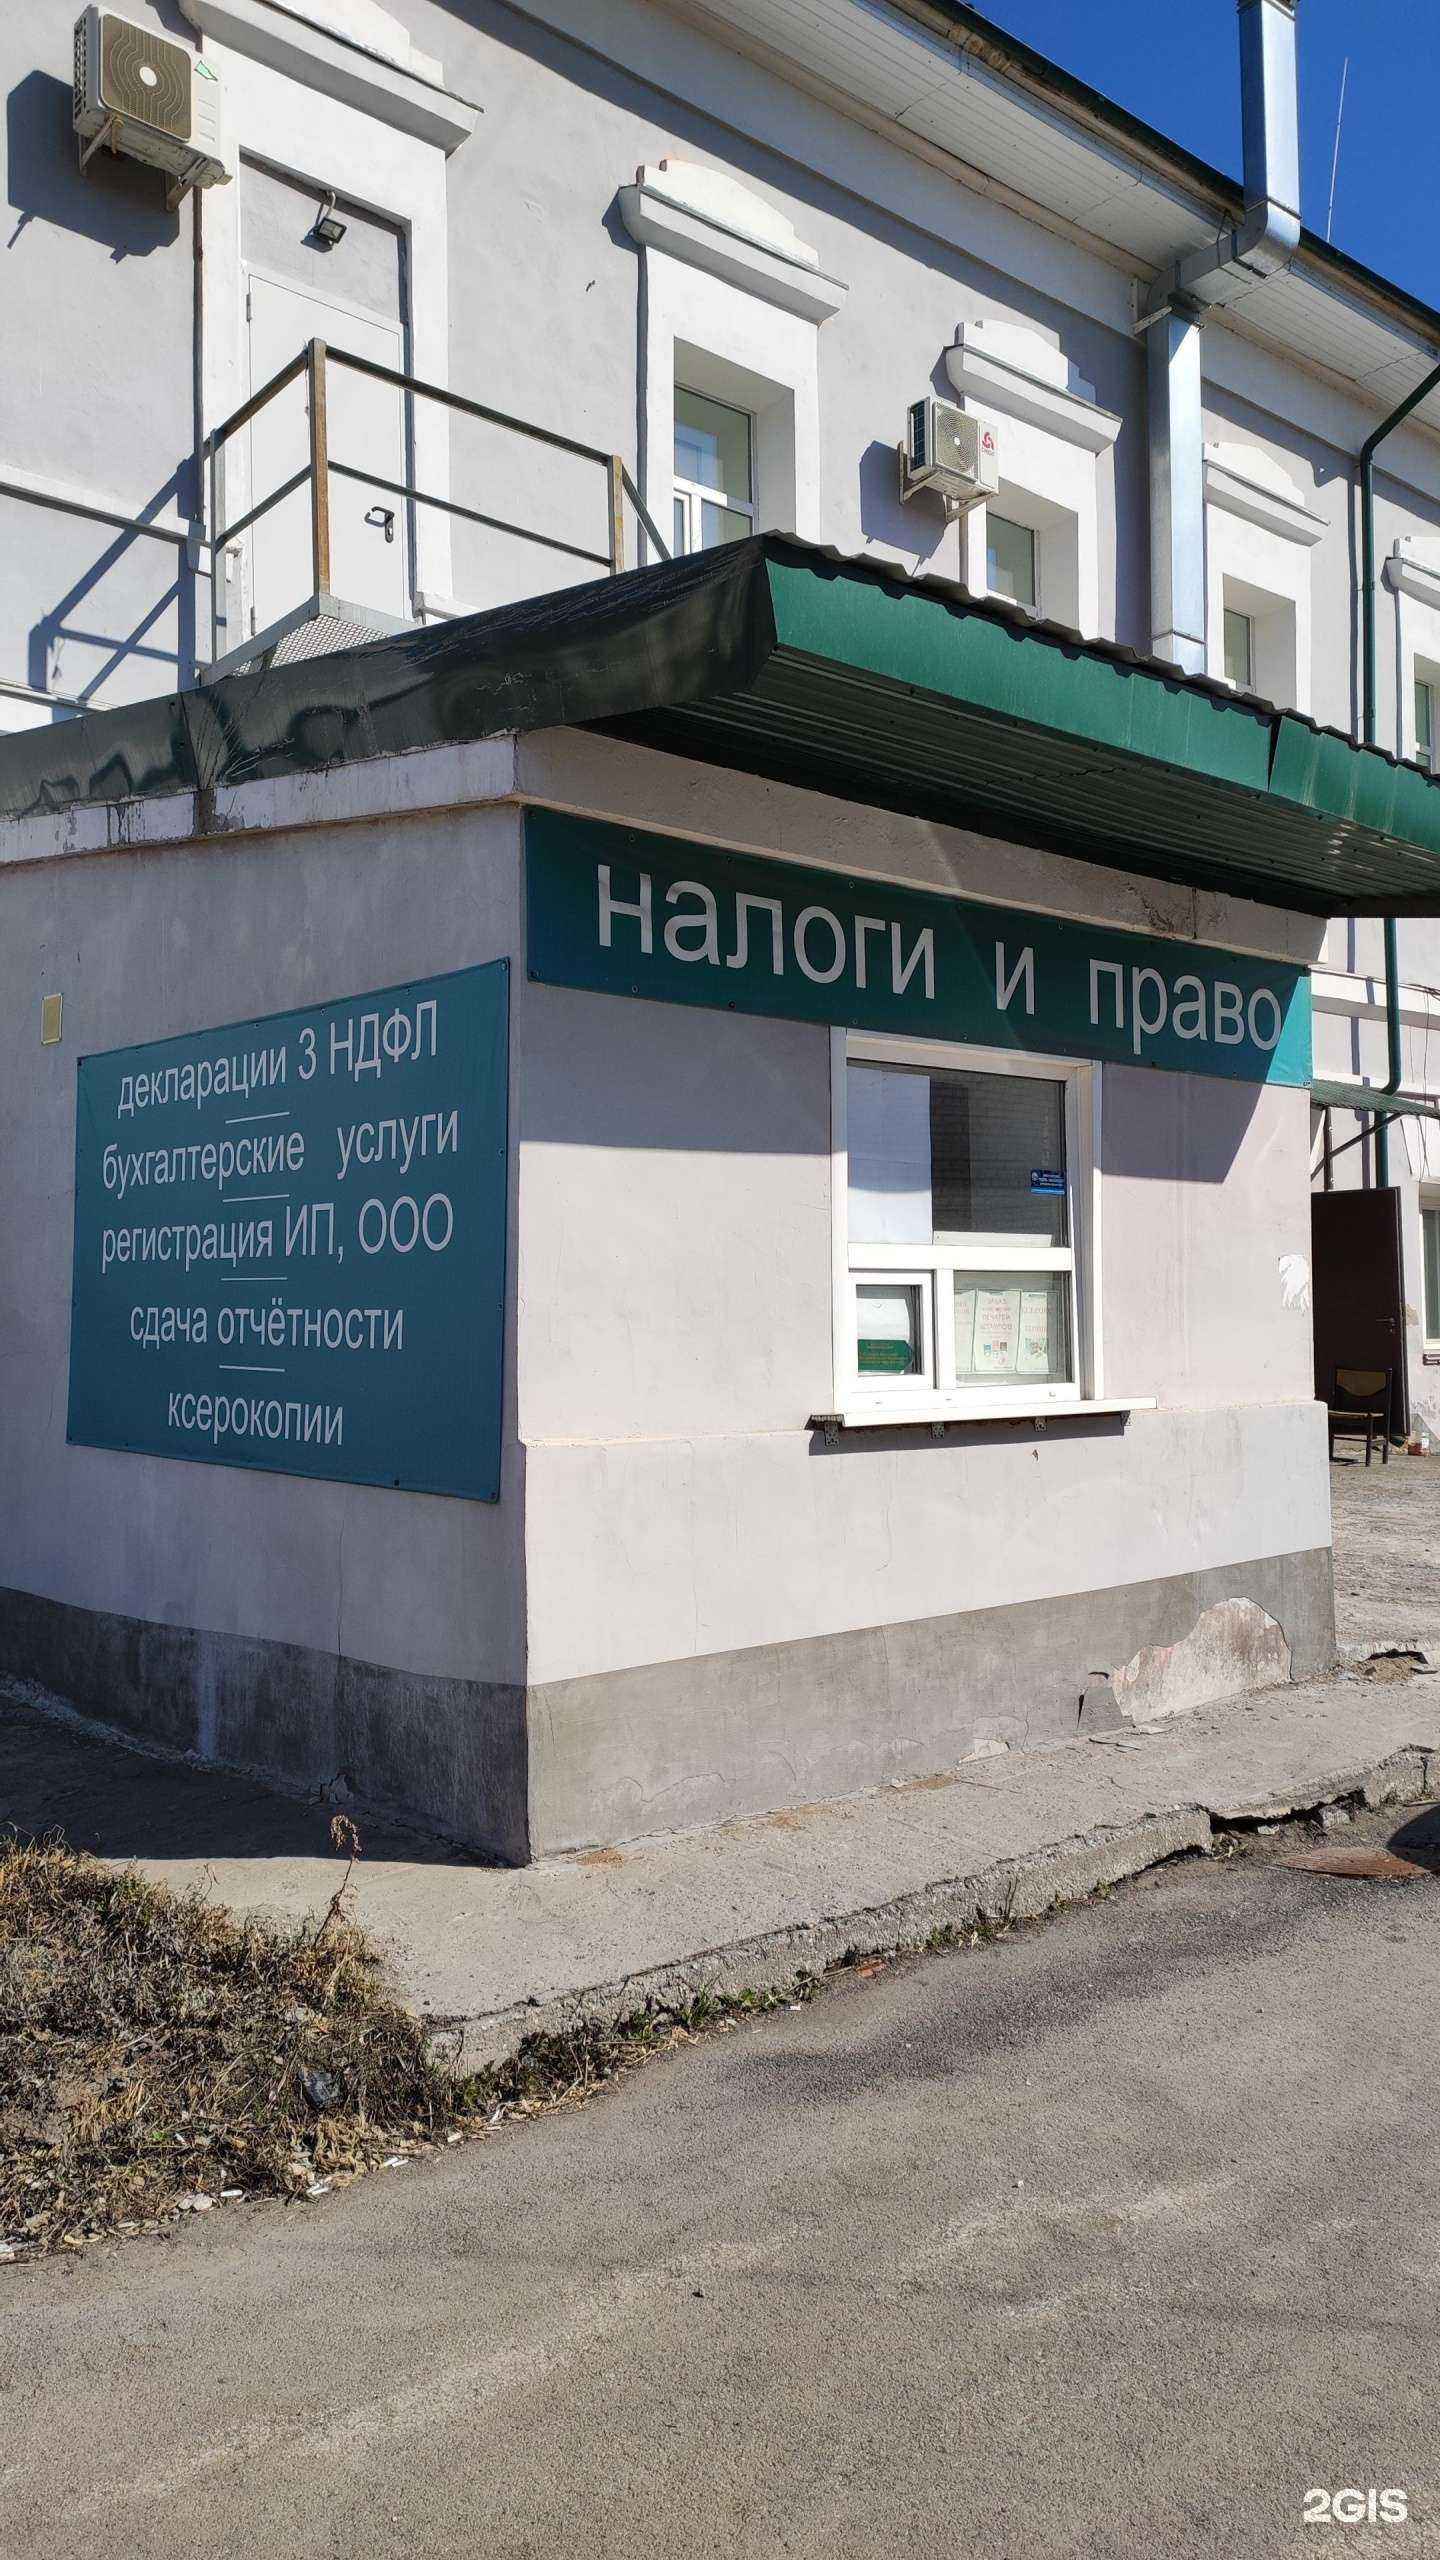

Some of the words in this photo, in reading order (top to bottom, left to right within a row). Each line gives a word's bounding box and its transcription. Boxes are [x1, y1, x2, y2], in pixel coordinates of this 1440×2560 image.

[597, 864, 936, 999] налоги
[996, 941, 1035, 1015] и
[1089, 958, 1283, 1054] право
[118, 1045, 287, 1118] декларации
[330, 999, 437, 1081] НДФЛ
[102, 1132, 305, 1200] бухгалтерские
[336, 1110, 458, 1180] услуги
[102, 1220, 273, 1274] регистрация
[285, 1202, 343, 1264] ИП,
[358, 1192, 453, 1254] ООО
[130, 1305, 207, 1349] сдача
[217, 1298, 403, 1350] отчётности
[168, 1391, 343, 1446] ксерокопии
